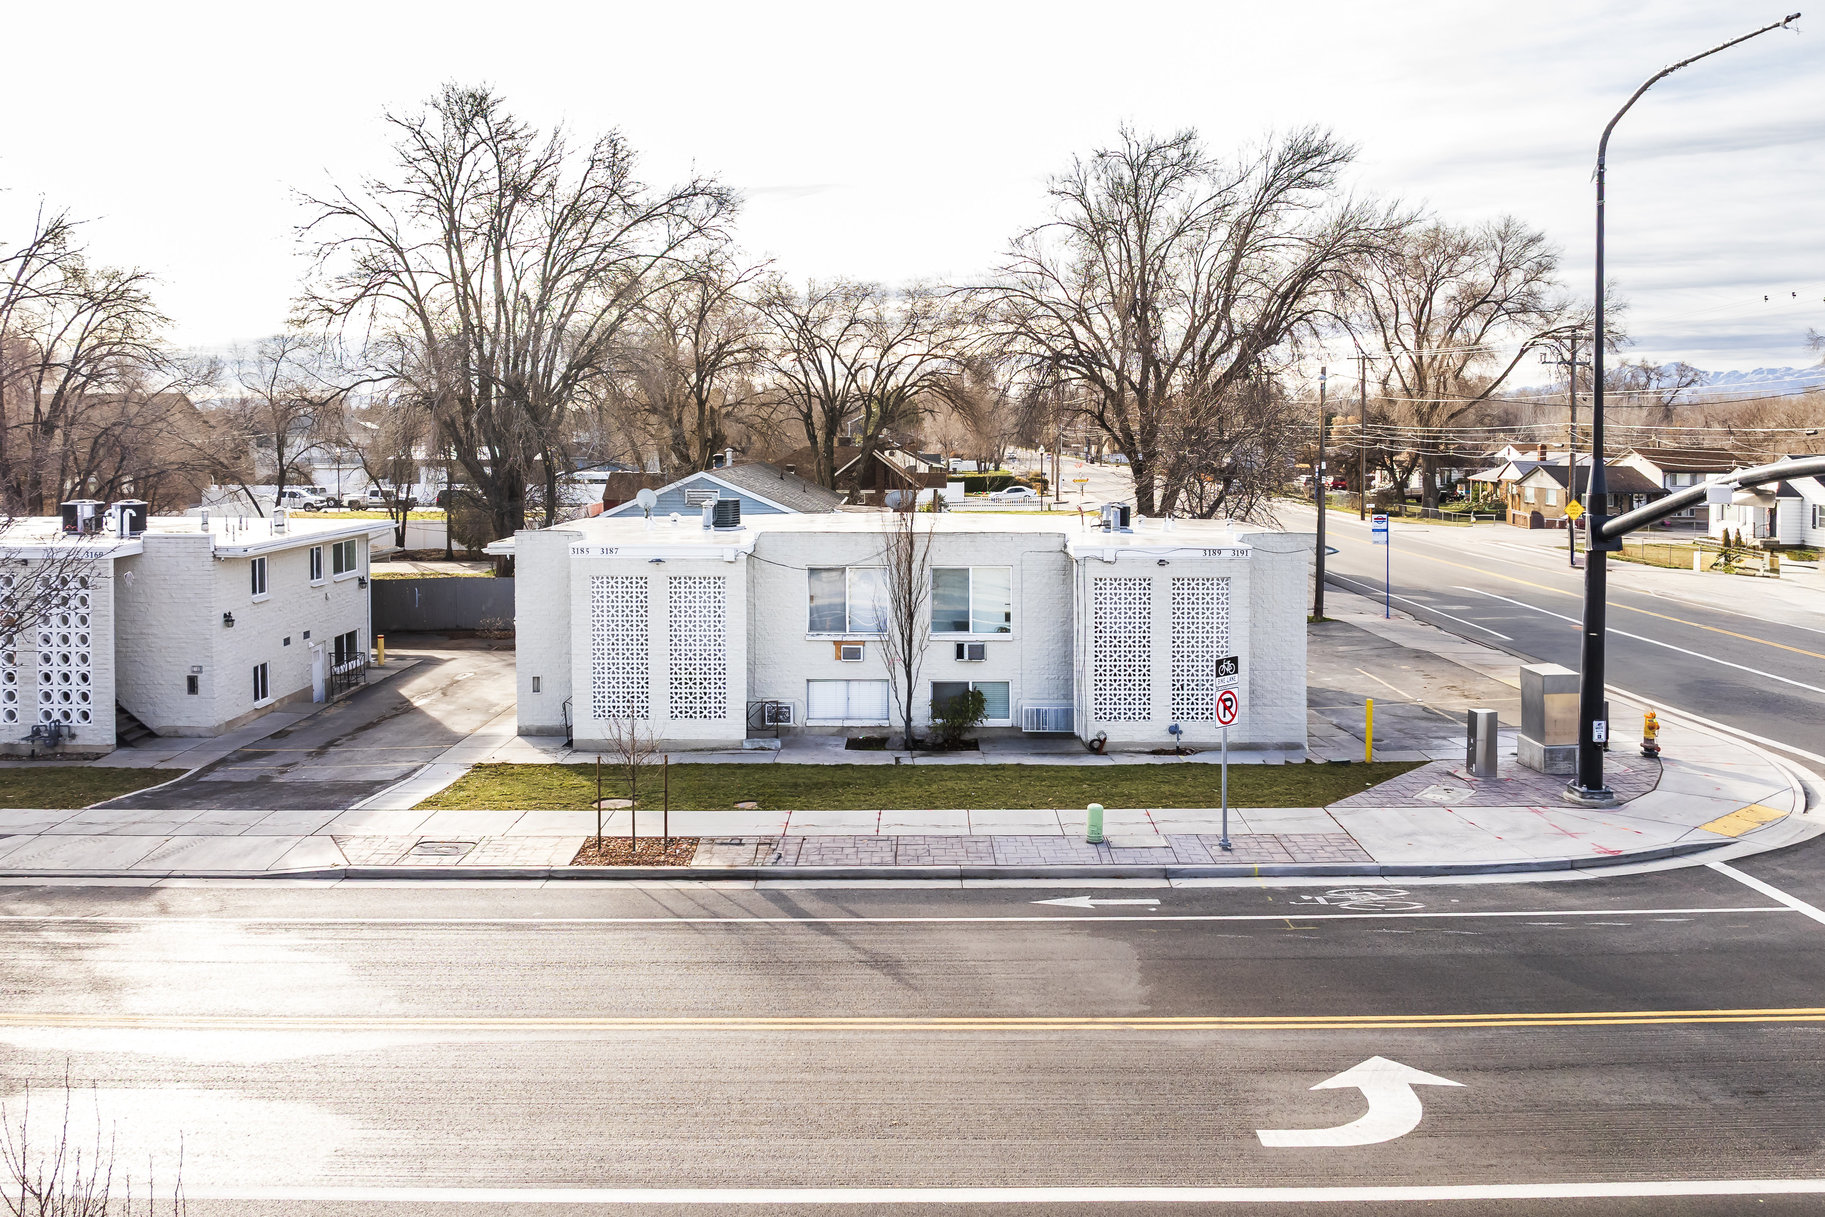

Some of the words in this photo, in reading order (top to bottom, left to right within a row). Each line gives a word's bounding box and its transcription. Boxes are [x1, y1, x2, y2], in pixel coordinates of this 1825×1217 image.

[571, 547, 590, 555] 3185
[600, 547, 619, 555] 3187
[1202, 549, 1222, 557] 3189
[1231, 549, 1249, 557] 3191
[1226, 675, 1237, 683] LANE
[1223, 697, 1234, 718] P
